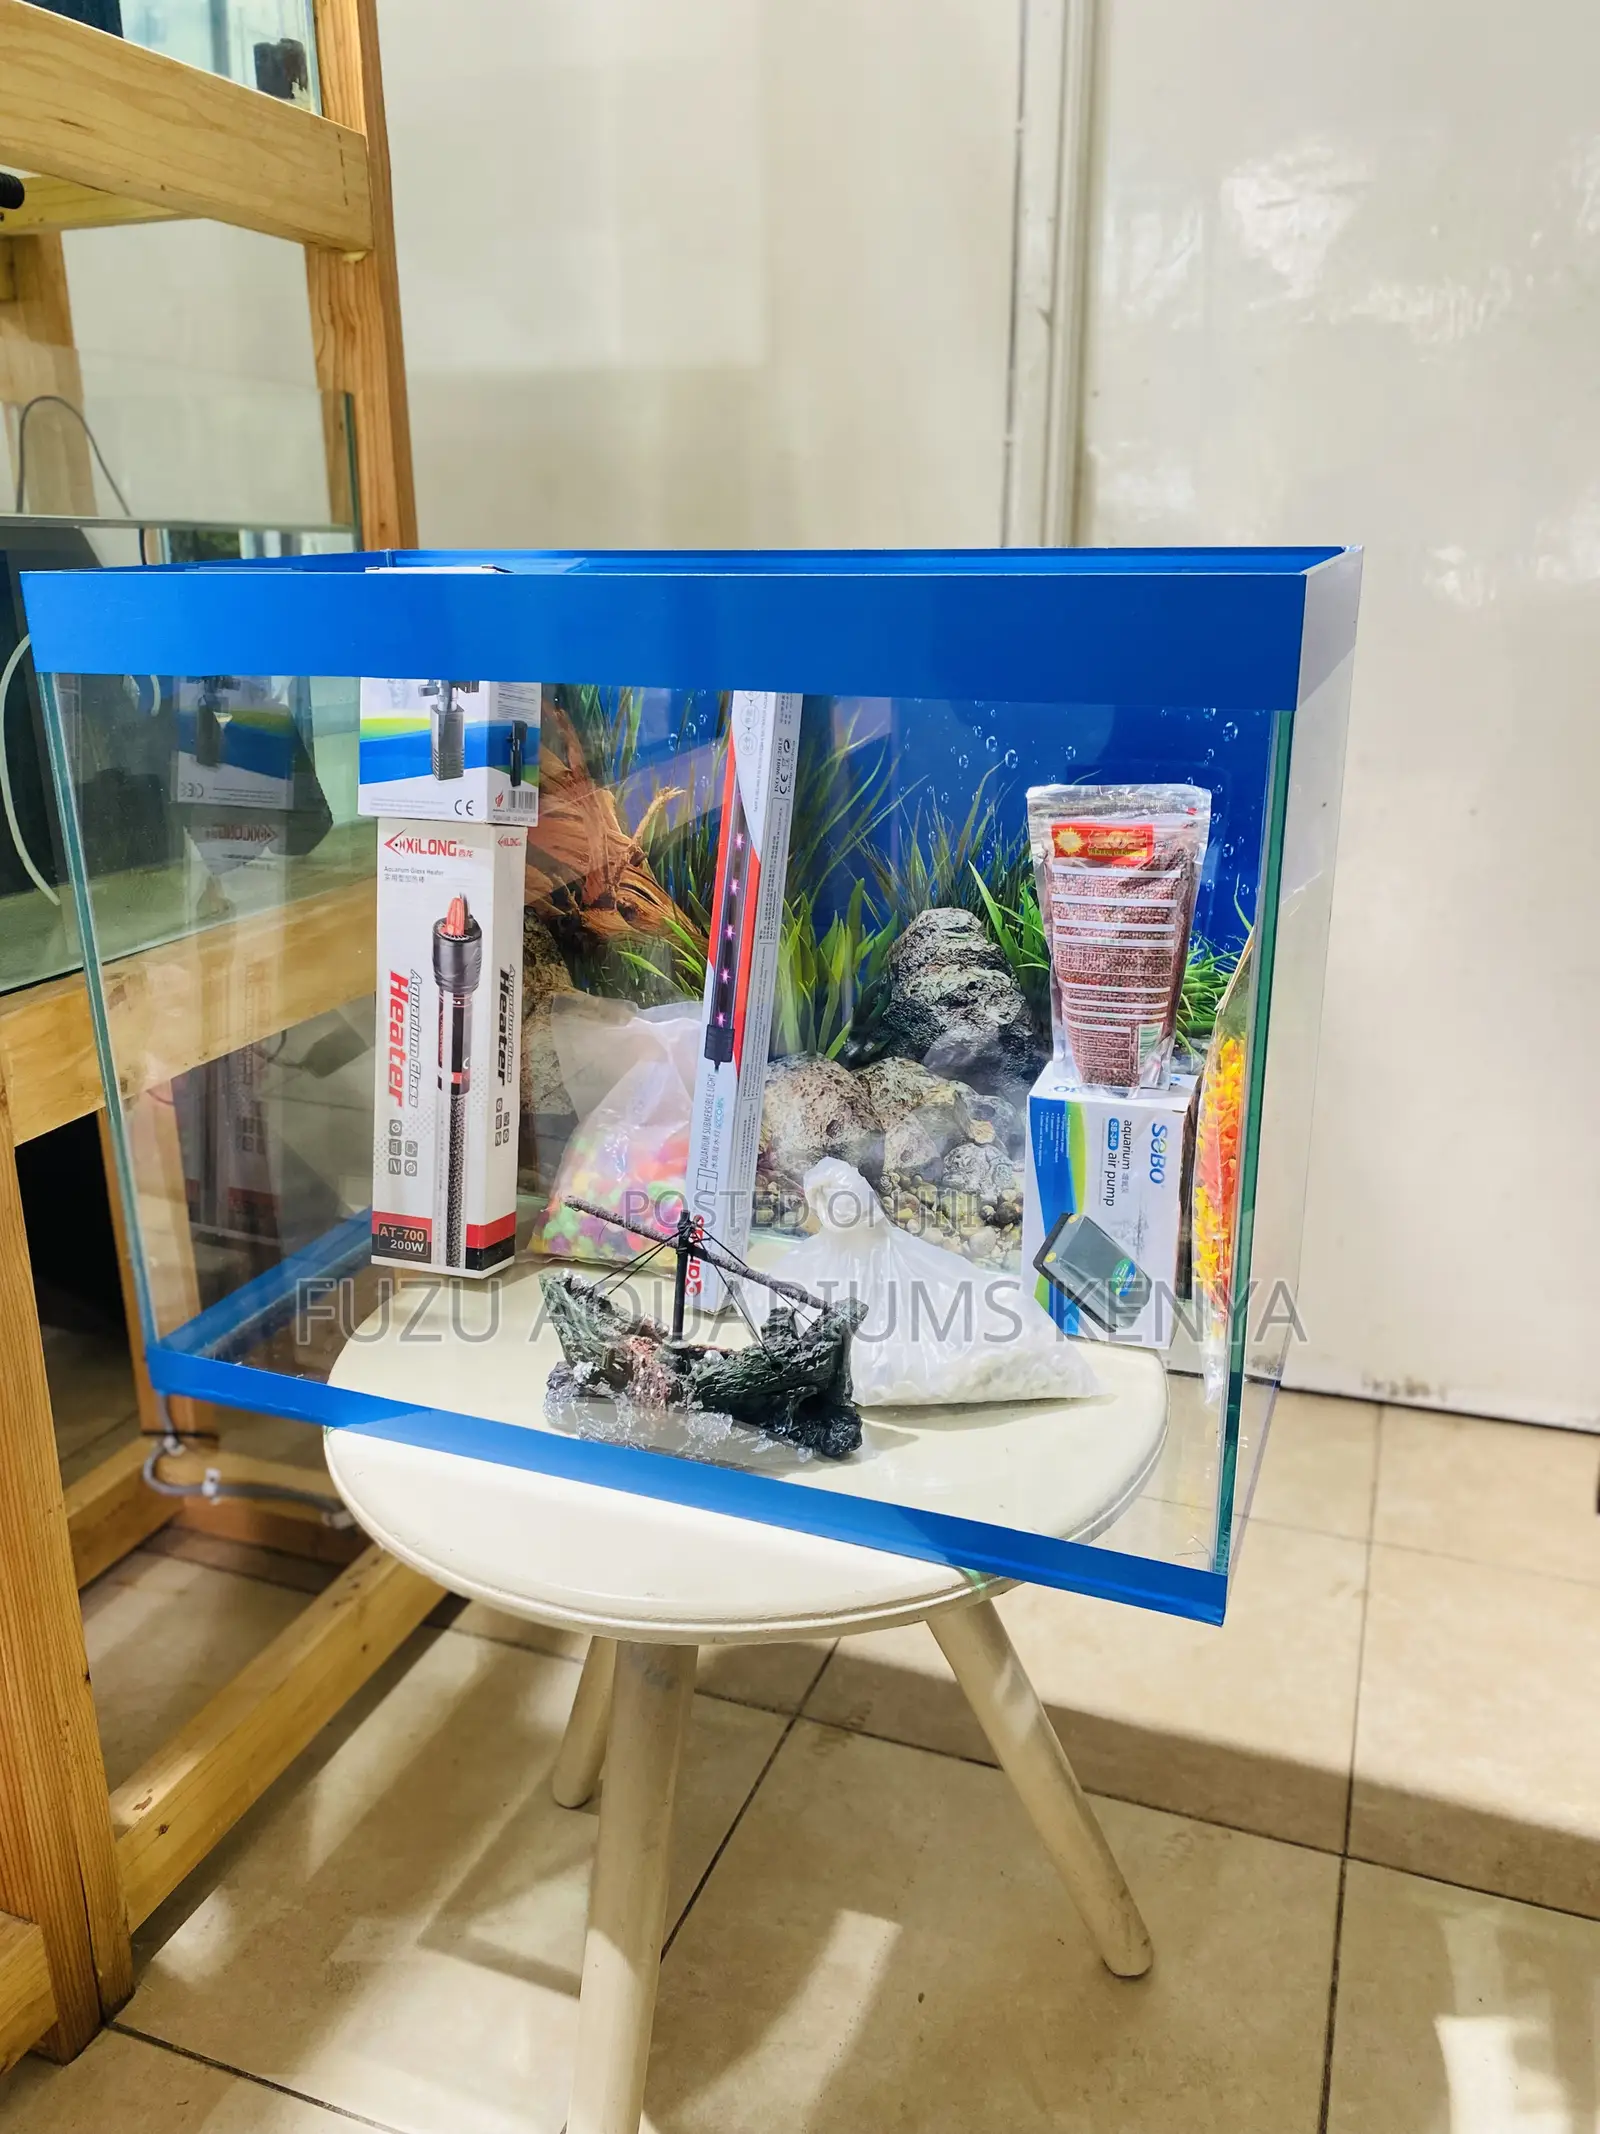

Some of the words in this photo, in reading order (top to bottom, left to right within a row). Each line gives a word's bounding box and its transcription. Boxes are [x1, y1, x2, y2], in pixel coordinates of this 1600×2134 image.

[454, 799, 474, 816] CE
[408, 968, 422, 1058] Aquarium
[498, 967, 509, 1086] Heater
[389, 970, 409, 1107] Heater
[408, 1058, 421, 1109] Glass
[707, 1073, 716, 1092] LIGHT
[703, 1093, 714, 1135] SUBMERSIBLE
[700, 1135, 711, 1169] AQUARIUM
[1108, 1152, 1120, 1169] air
[1121, 1119, 1134, 1170] aquarium
[1103, 1171, 1116, 1207] pump
[380, 1226, 425, 1242] AT-700
[390, 1239, 424, 1253] 200W
